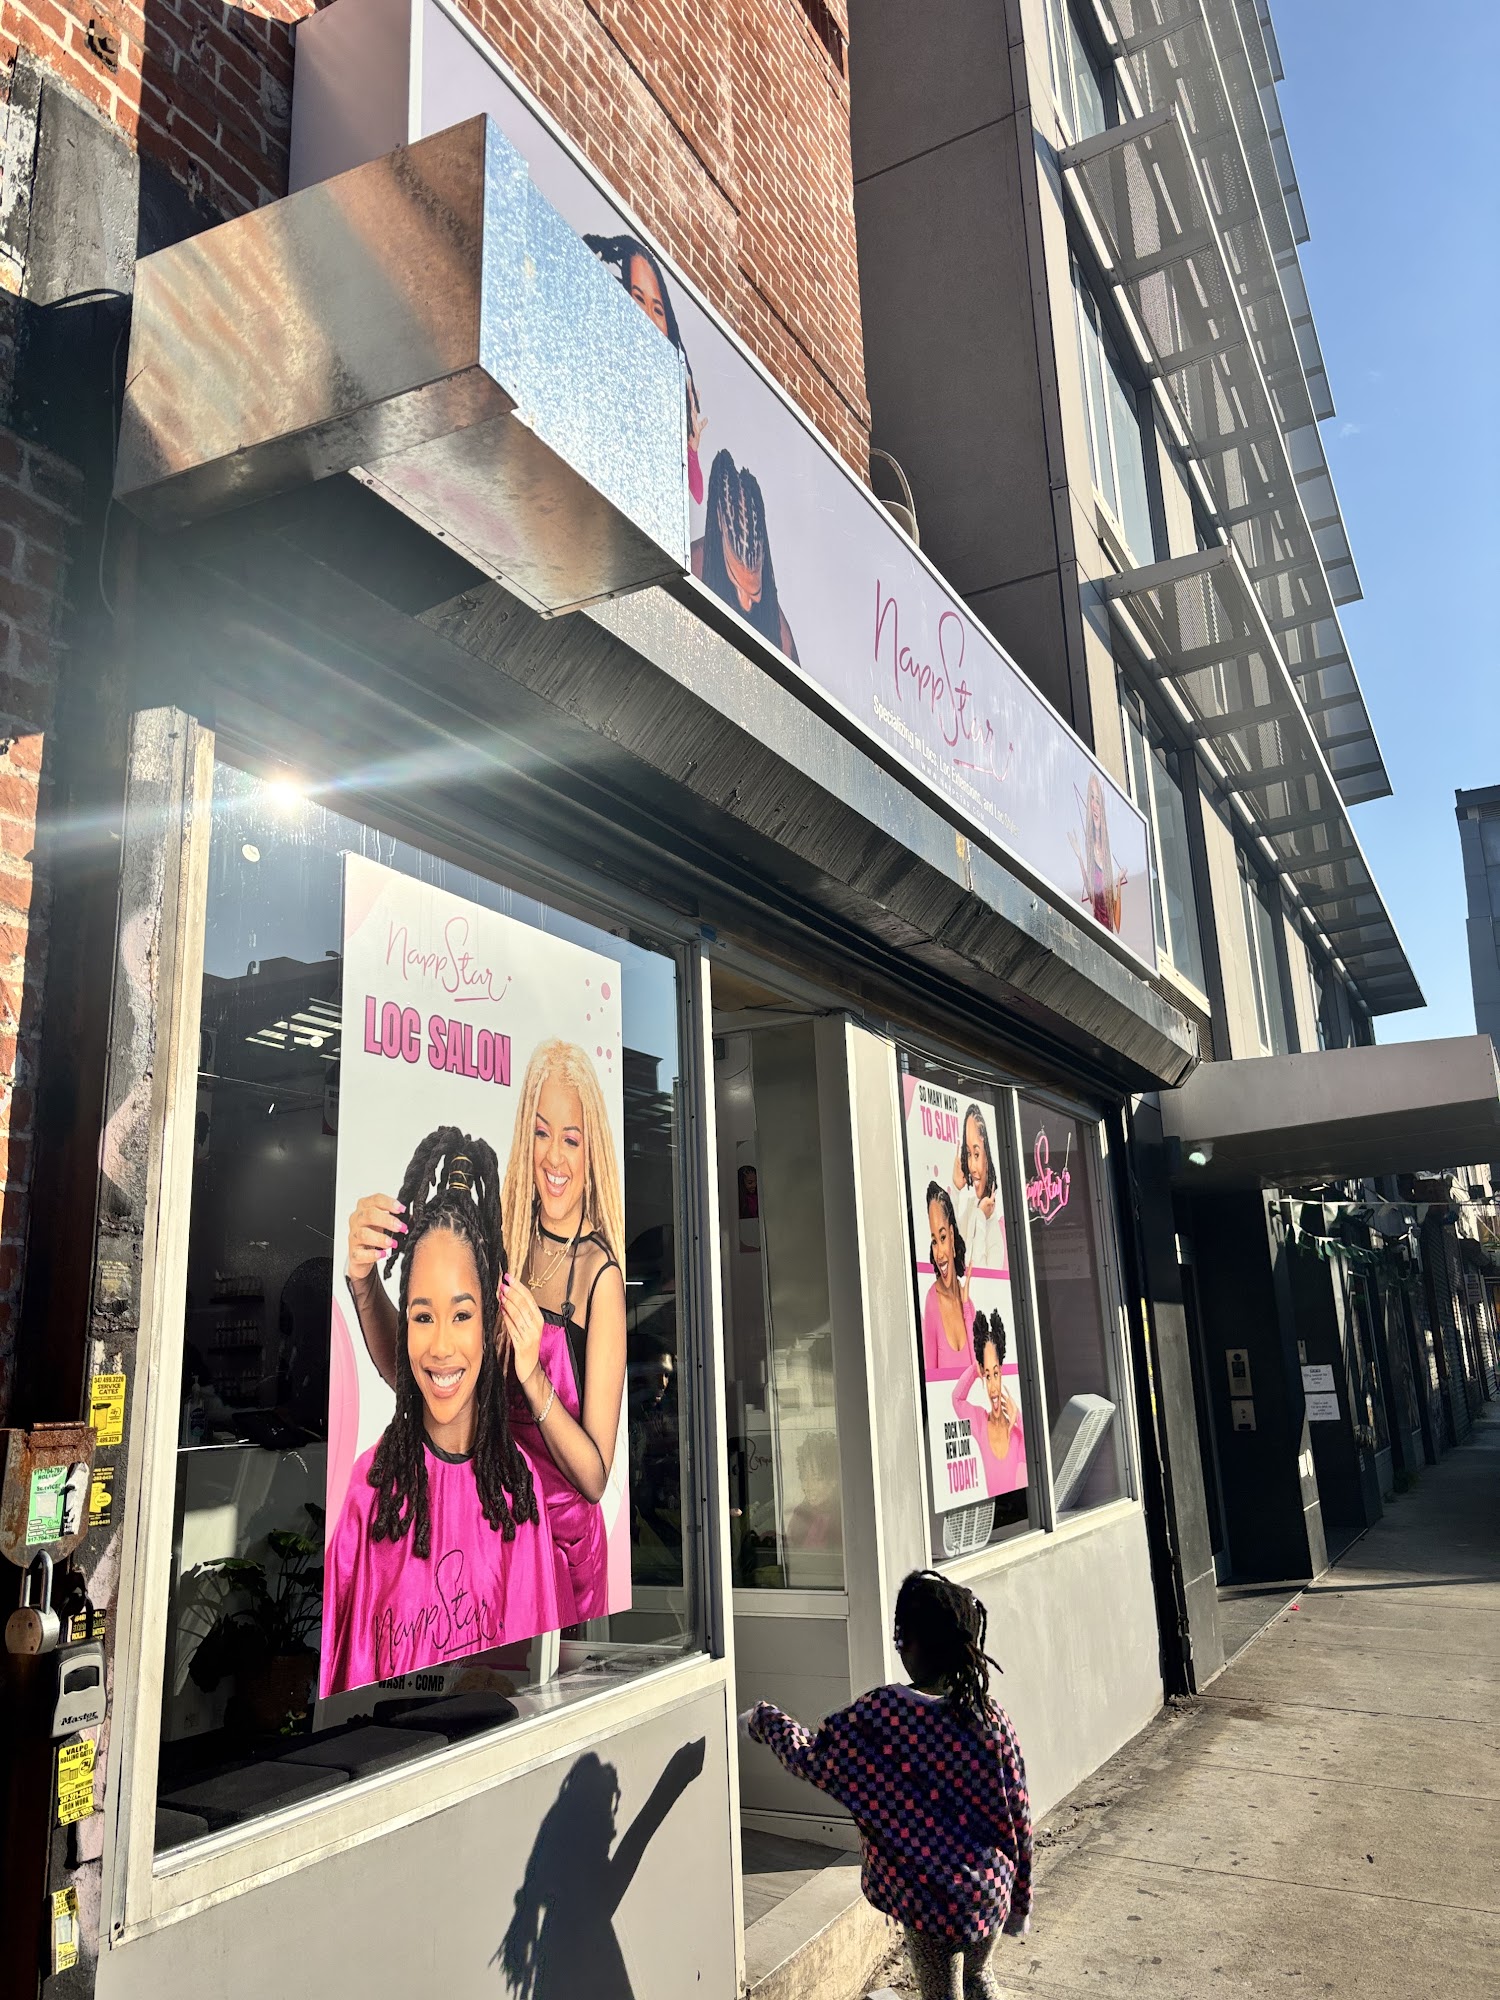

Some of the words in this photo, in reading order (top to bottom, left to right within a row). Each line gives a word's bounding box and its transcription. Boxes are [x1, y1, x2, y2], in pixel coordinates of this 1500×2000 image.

[873, 694, 914, 750] Specializing
[386, 916, 513, 1002] NappStar
[364, 994, 421, 1064] LOC
[428, 1014, 511, 1087] SALON
[919, 1084, 927, 1103] SO
[927, 1087, 943, 1109] MANY
[943, 1093, 958, 1114] WAYS
[920, 1105, 933, 1138] TO
[935, 1109, 960, 1145] SLAY!
[944, 1421, 958, 1441] ROCK
[958, 1419, 972, 1438] YOUR
[945, 1441, 957, 1460] NEW
[958, 1438, 971, 1457] LOOK
[946, 1457, 979, 1495] TODAY!
[375, 1549, 504, 1677] NappStar
[415, 1674, 445, 1692] COMB
[61, 1711, 97, 1726] Master
[60, 1752, 80, 1764] ROLLING
[80, 1747, 94, 1758] GATES
[66, 1743, 89, 1756] VALPO
[63, 1801, 74, 1812] IRON
[75, 1796, 89, 1807] WORK
